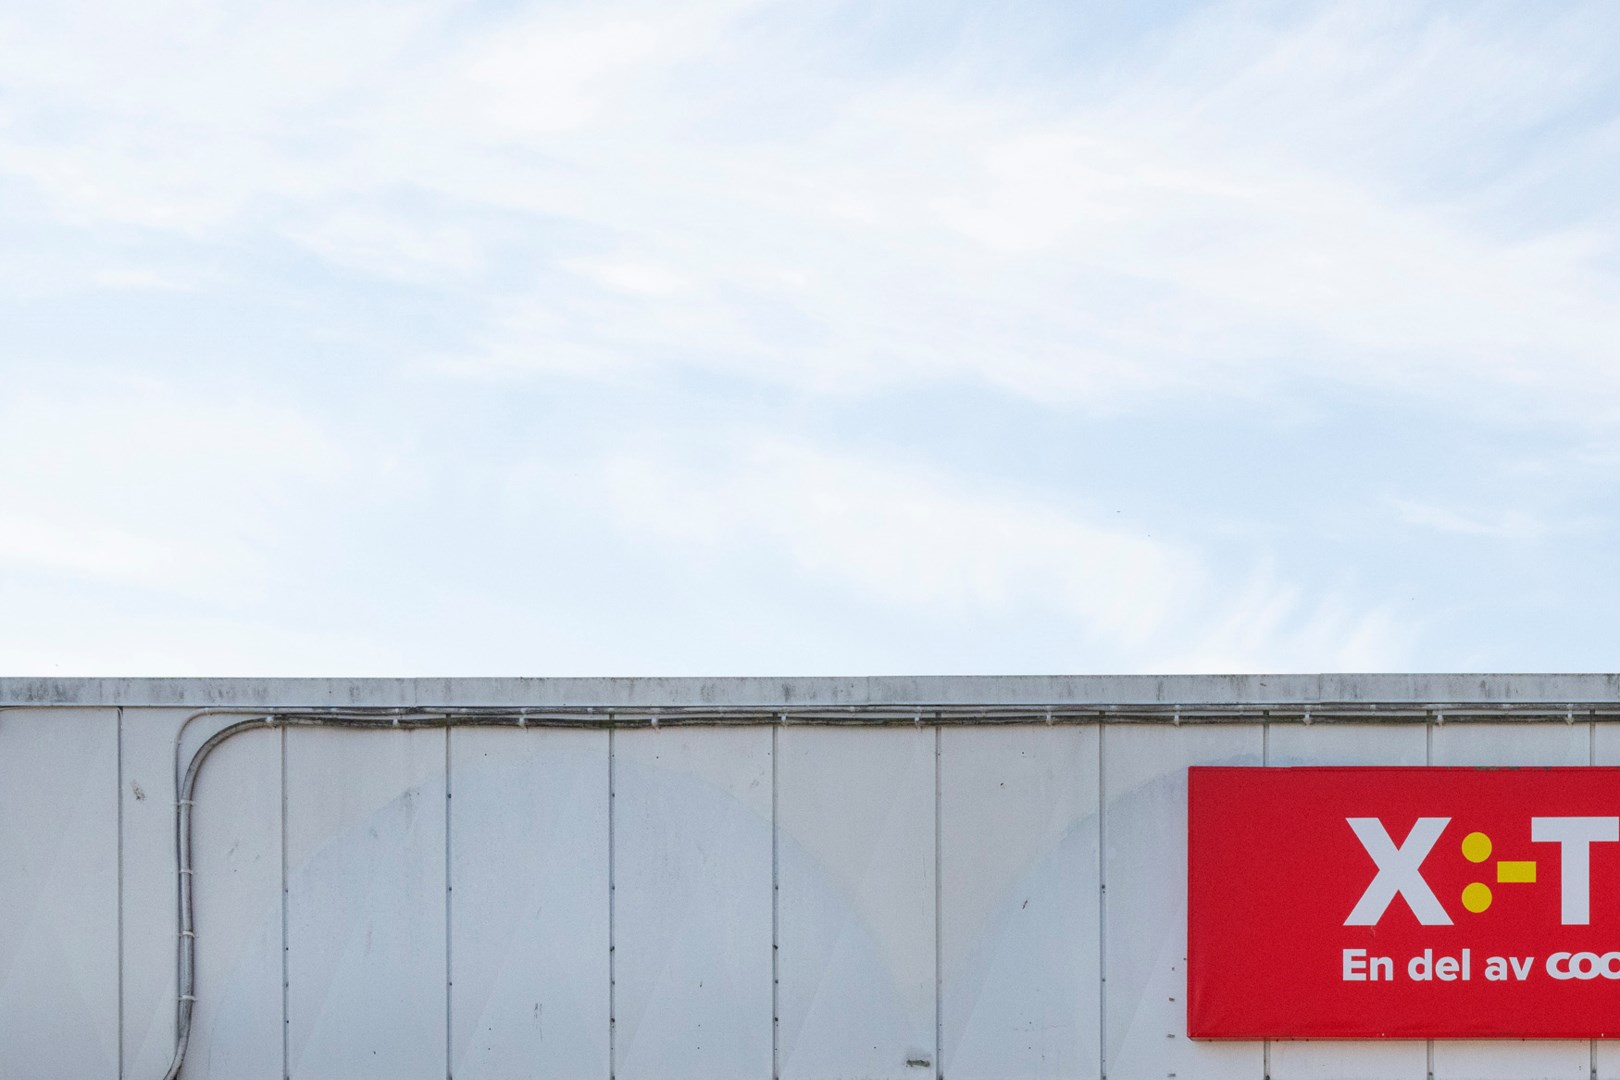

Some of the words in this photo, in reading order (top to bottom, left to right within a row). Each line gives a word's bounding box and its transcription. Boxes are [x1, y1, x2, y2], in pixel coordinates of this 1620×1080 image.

[1343, 949, 1394, 981] En
[1407, 948, 1471, 981] del
[1484, 956, 1534, 981] av
